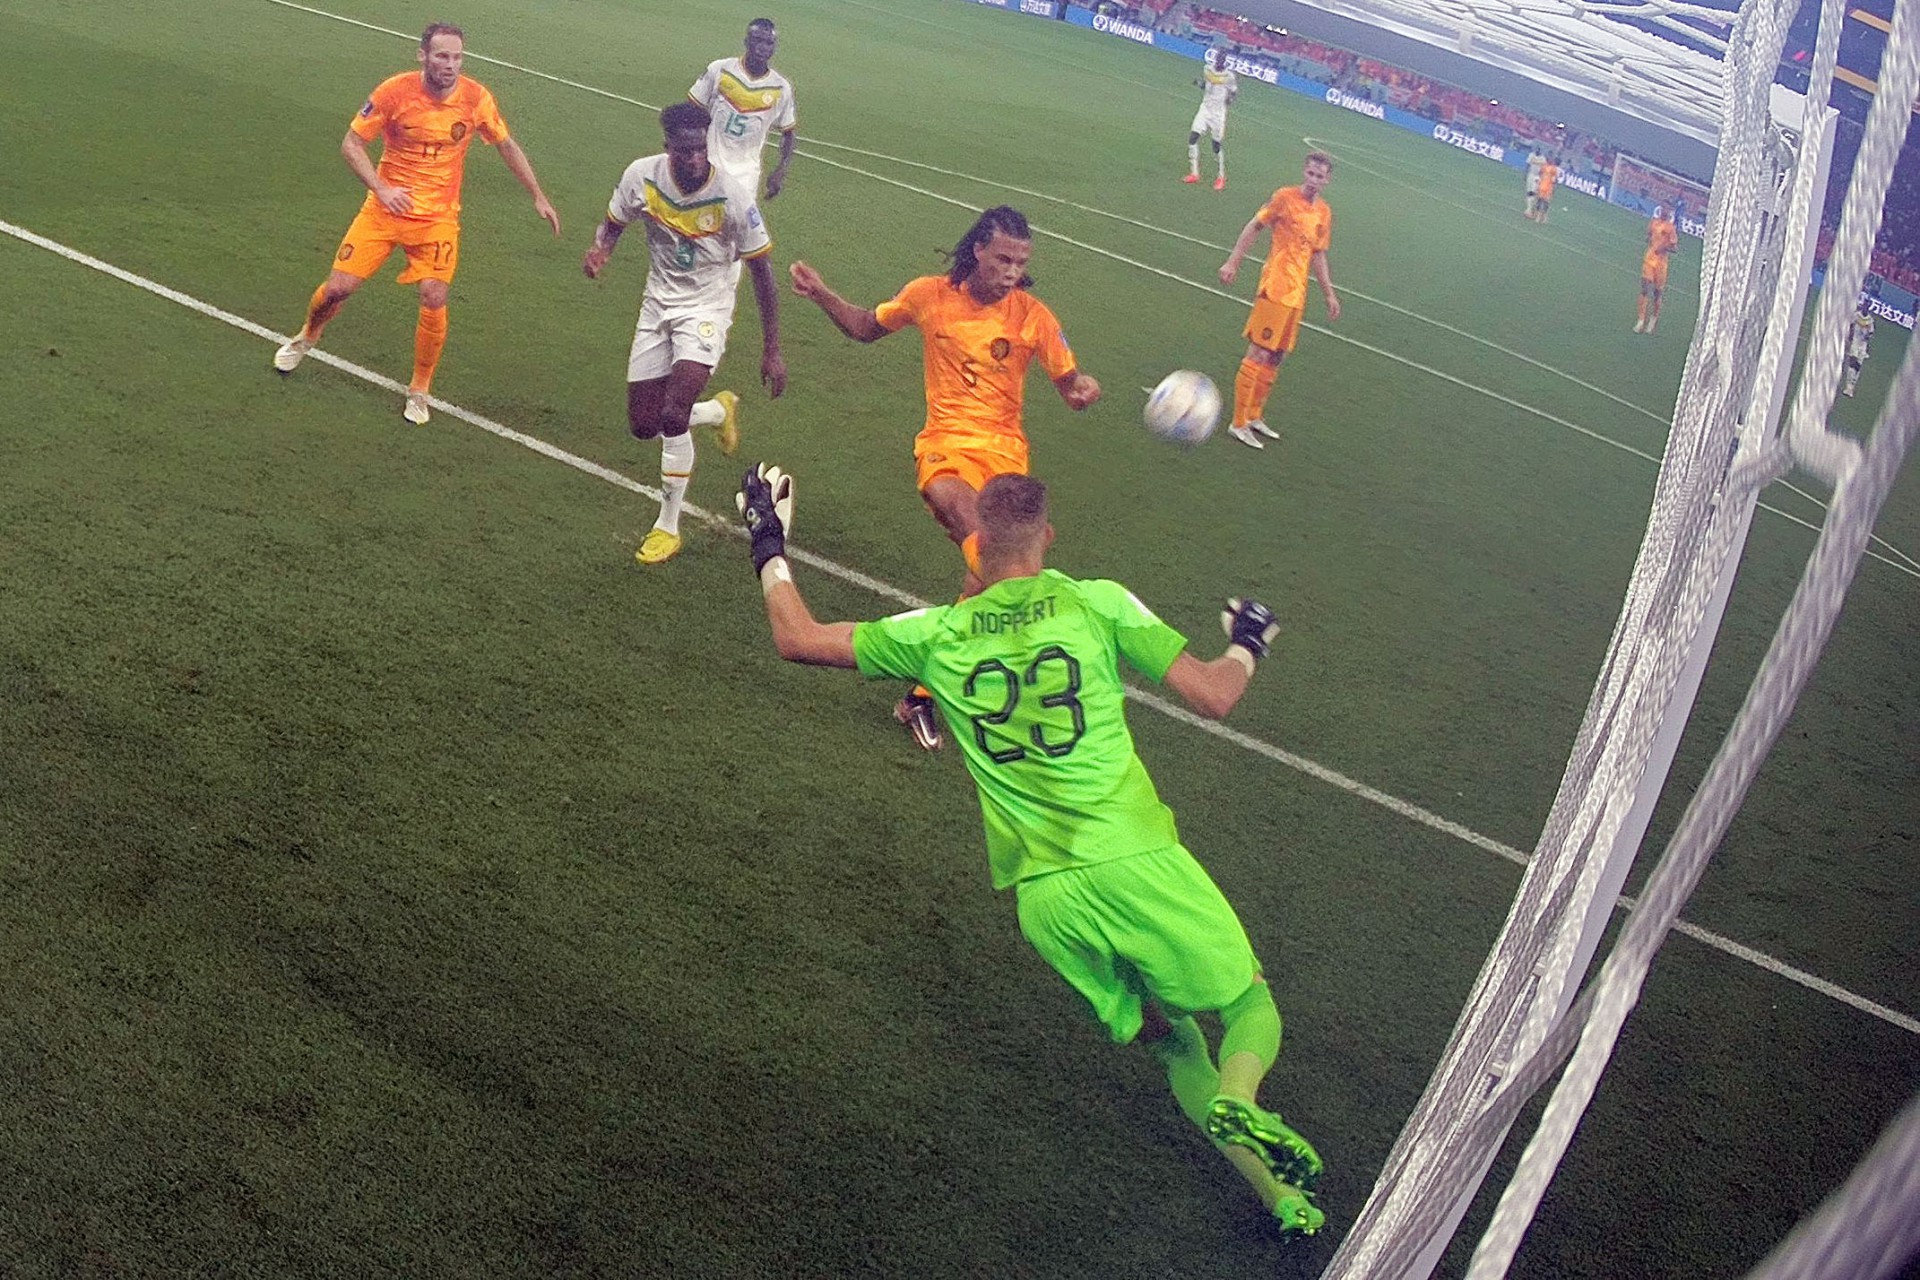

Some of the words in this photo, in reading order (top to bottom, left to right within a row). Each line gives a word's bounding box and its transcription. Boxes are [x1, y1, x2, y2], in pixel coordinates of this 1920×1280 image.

[1107, 20, 1152, 44] WANDA
[1341, 94, 1384, 119] WANDA
[724, 112, 749, 137] 15
[433, 242, 453, 265] 17
[1868, 297, 1915, 331] 万达文旅
[970, 595, 1057, 635] NOPPERT
[963, 644, 1086, 765] 23
